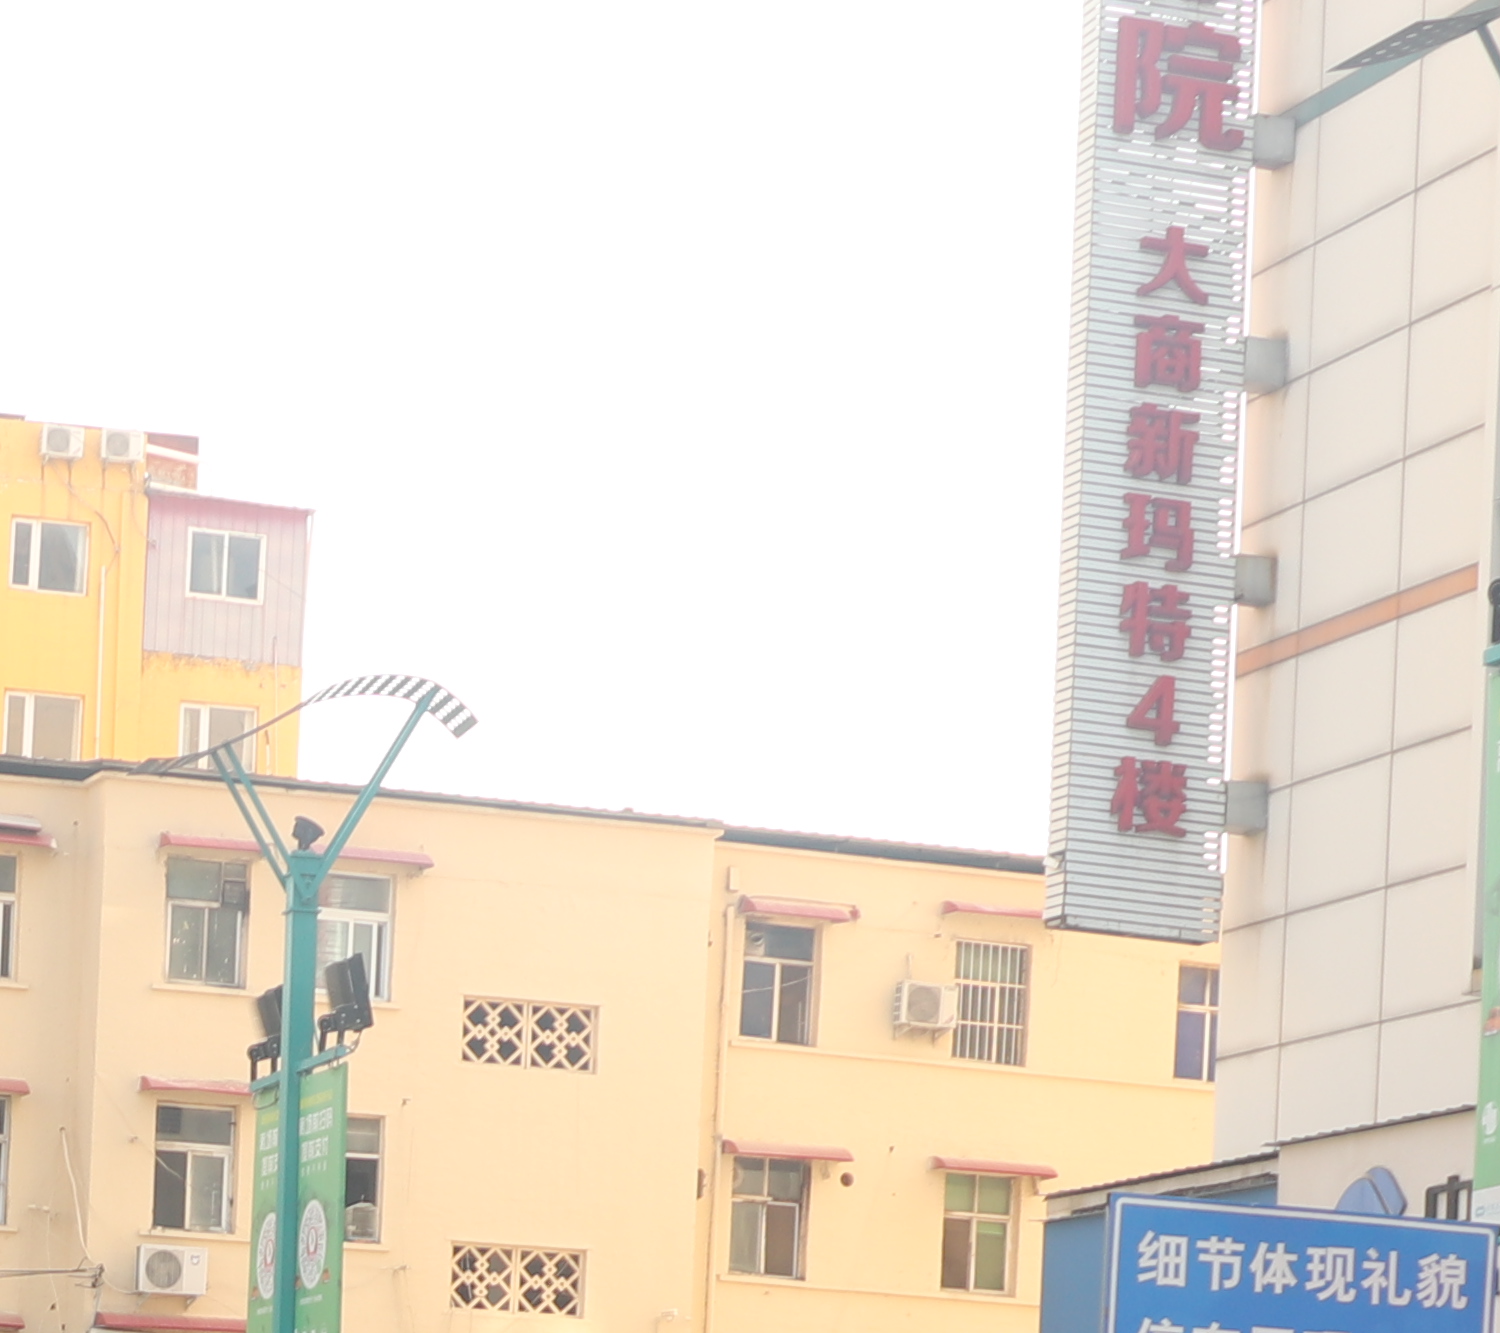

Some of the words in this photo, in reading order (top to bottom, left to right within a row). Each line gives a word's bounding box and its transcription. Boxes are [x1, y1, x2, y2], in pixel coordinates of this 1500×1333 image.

[1113, 16, 1244, 150] 院
[1109, 226, 1210, 838] 大商新玛特4楼
[1136, 1230, 1469, 1310] 细节体现礼貌
